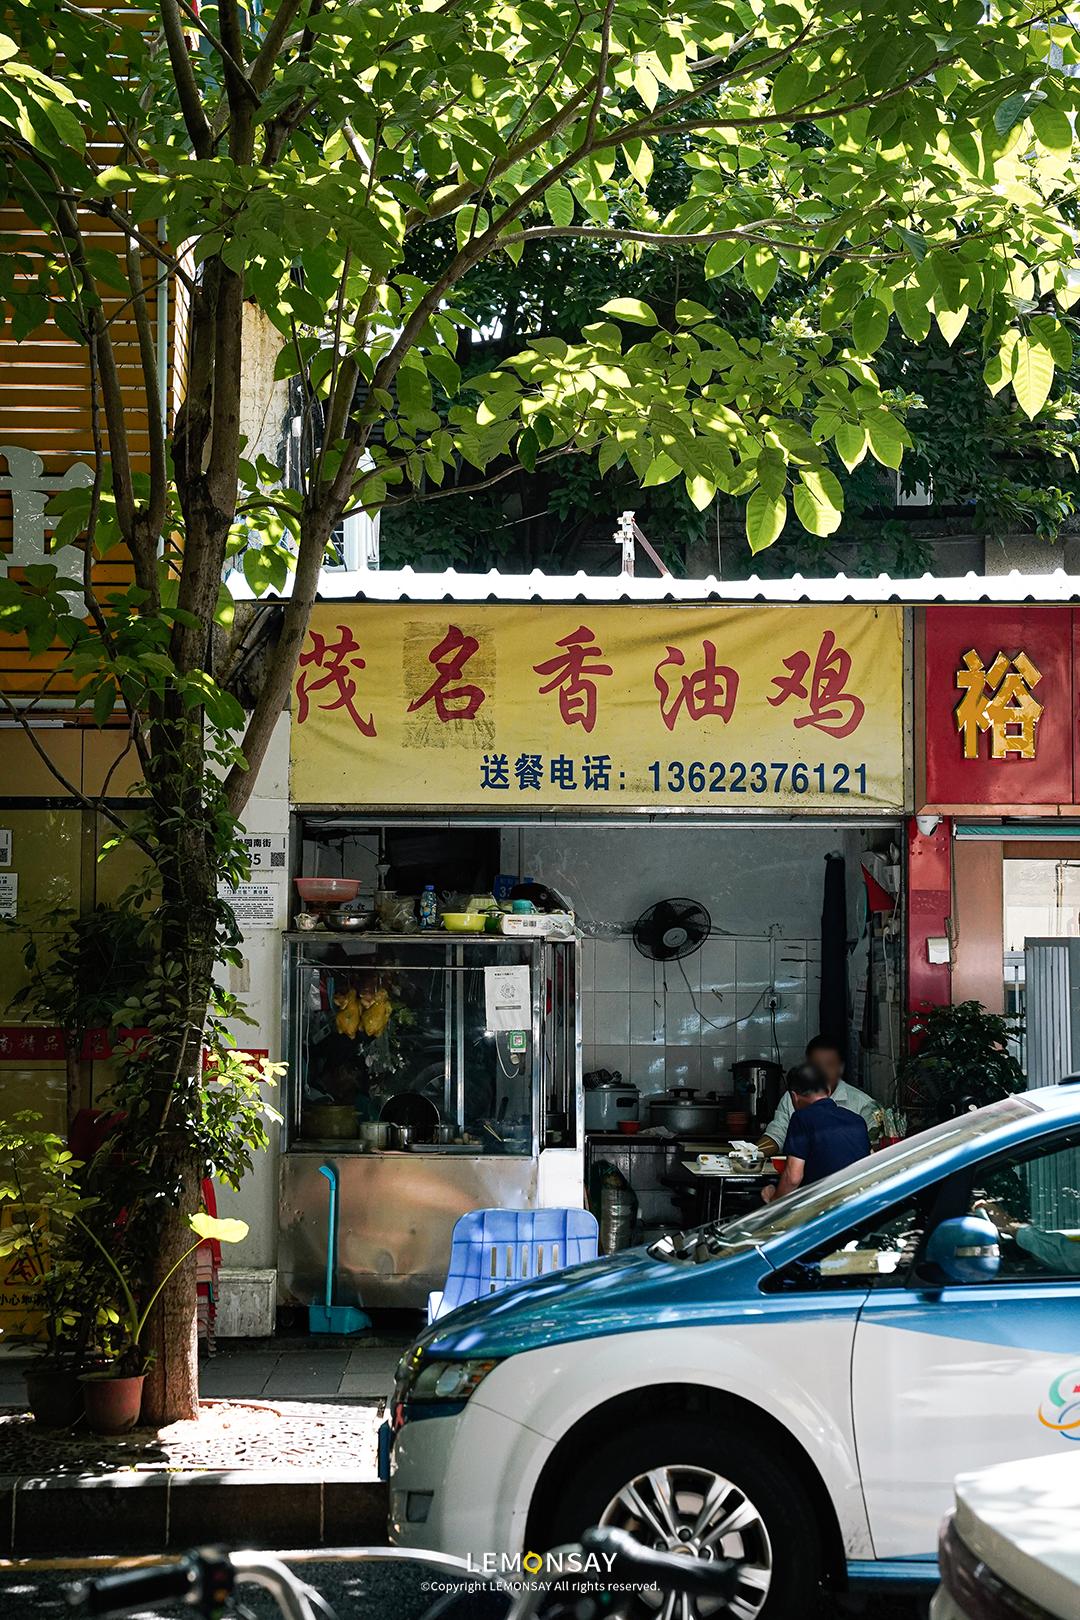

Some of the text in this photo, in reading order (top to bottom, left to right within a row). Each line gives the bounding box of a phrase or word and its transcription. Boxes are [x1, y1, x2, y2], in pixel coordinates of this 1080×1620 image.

[296, 625, 865, 738] 茂名香油鸡
[957, 649, 1045, 758] 裕
[648, 760, 866, 794] 13622376121
